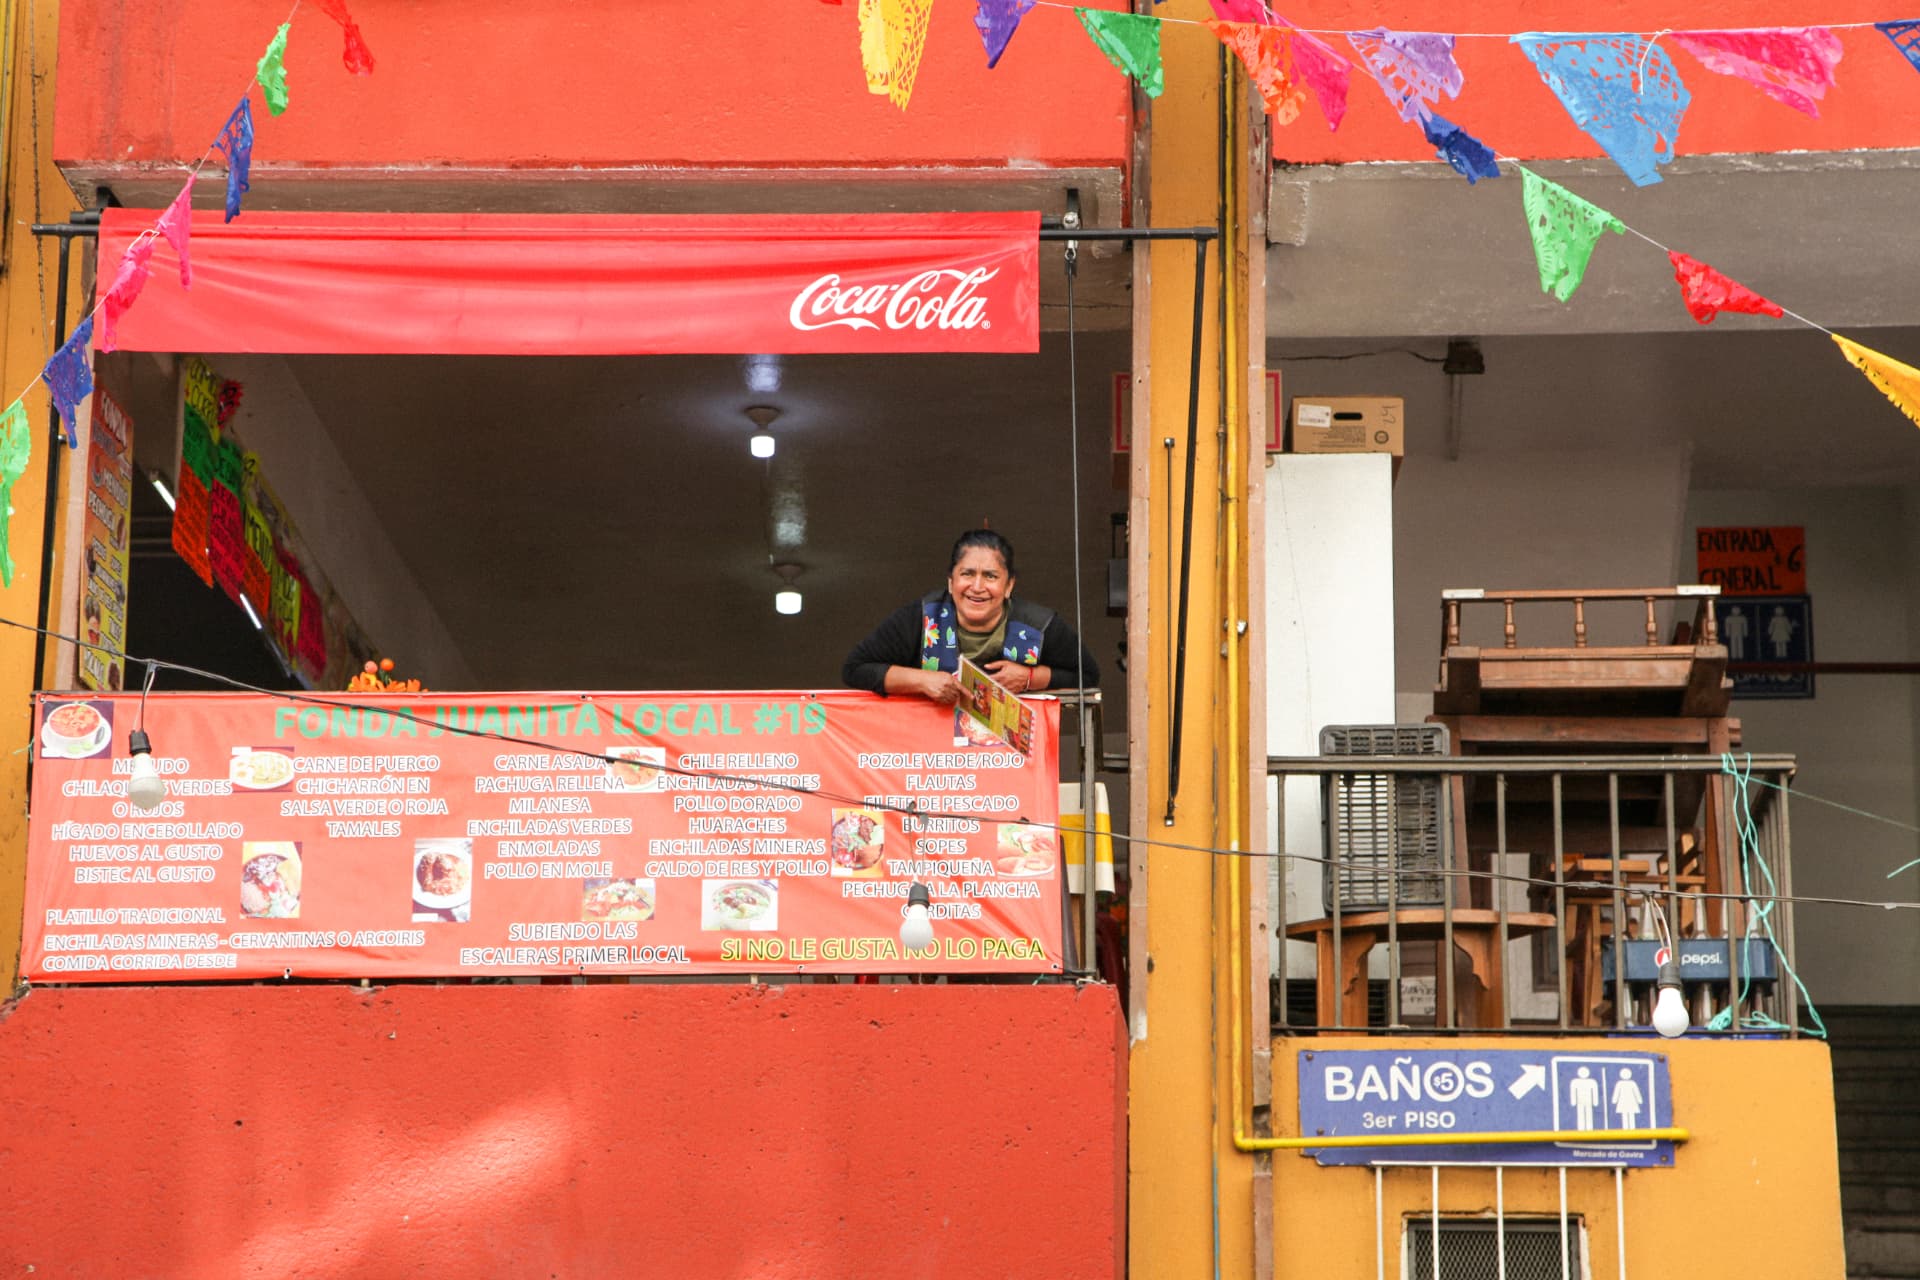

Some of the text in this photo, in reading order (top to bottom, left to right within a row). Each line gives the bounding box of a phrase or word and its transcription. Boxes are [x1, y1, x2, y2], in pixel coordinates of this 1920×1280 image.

[789, 266, 1000, 331] Coca-Cola
[1699, 529, 1776, 553] ENTRADA
[275, 703, 827, 739] FONDA JUANITA LOCAL #19
[112, 757, 189, 775] MEUDO
[292, 756, 440, 773] CARNE DE PUERCO
[494, 755, 607, 771] CARNE ASADA
[678, 754, 798, 769] CHILE RELLENO
[858, 754, 1025, 769] POZOLE VERDE/ROJO
[171, 780, 232, 796] VERDES
[296, 775, 430, 794] CHICHARRÓN EN
[475, 776, 625, 792] PACHUGA RELLENA
[657, 775, 821, 791] ENCHILADAS VERDES
[906, 774, 977, 791] FLAUTAS
[112, 801, 184, 818] O ROJOS
[281, 799, 448, 817] SALSA VERDE O ROJA
[509, 798, 592, 814] MILANESA
[674, 797, 802, 812] POLLO DORADO
[916, 796, 936, 811] DE
[937, 796, 1019, 811] PESCADO
[52, 822, 243, 840] HÍGADO ENCEBOLLADO
[327, 821, 401, 837] TAMALES
[466, 819, 632, 836] ENCHILADAS VERDES
[689, 818, 787, 833] HUARACHES
[902, 817, 980, 833] BURRITOS
[69, 845, 223, 862] HUEVOS AL GUSTO
[497, 840, 600, 857] ENMOLADAS
[649, 840, 826, 855] ENCHILADAS MINERAS
[915, 840, 966, 855] SOPES
[74, 866, 215, 883] BISTEC AL GUSTO
[484, 862, 614, 879] POLLO EN MOLE
[645, 861, 828, 877] CALDO DE RES Y POLLO
[888, 859, 995, 876] TAMPIQUEÑA
[842, 882, 914, 898] PECHUG
[939, 882, 962, 898] LA
[963, 882, 1040, 898] PLANCHA
[46, 908, 226, 925] PLATILLO TRADICIONAL
[509, 922, 637, 941] SUBIENDO LAS
[44, 935, 146, 951] ENCHILADAS
[147, 934, 218, 950] MINERAS
[229, 933, 337, 949] CERVANTINAS
[337, 933, 352, 948] O
[353, 931, 425, 947] ARCOIRIS
[721, 939, 743, 961] SI
[746, 939, 787, 960] NO
[789, 939, 817, 960] LE
[821, 939, 898, 961] GUSTA
[944, 939, 978, 959] LO
[981, 938, 1046, 960] PAGA
[43, 955, 237, 972] COMIDA CORRIDA DESDE
[460, 946, 690, 965] ESCALERAS PRIMER LOCAL
[1681, 953, 1721, 966] pepsi
[1325, 1056, 1495, 1103] BAÑOS
[1433, 1072, 1455, 1092] $5
[1362, 1111, 1456, 1129] 3er PISO
[1573, 1149, 1606, 1158] Mercado
[1607, 1150, 1618, 1158] de
